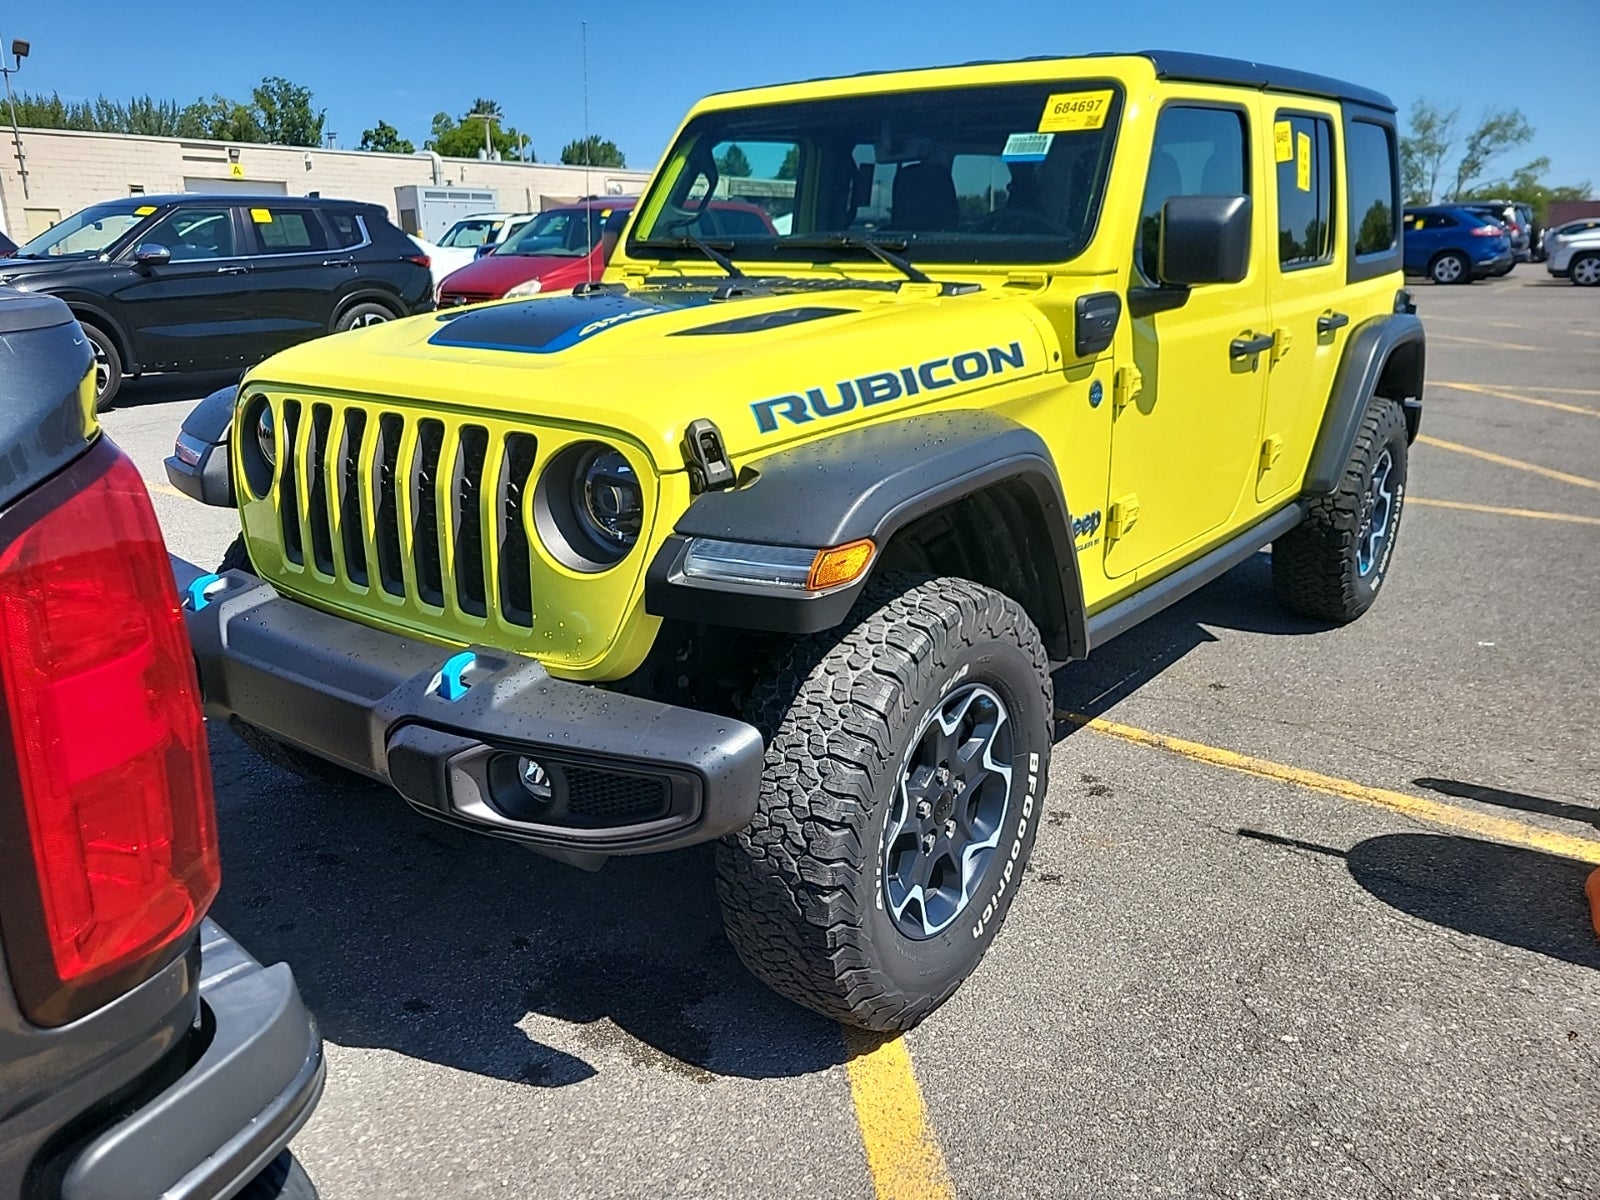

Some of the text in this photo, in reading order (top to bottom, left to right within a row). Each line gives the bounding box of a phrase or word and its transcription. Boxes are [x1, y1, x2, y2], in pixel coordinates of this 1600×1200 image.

[1054, 99, 1103, 114] 684697
[233, 166, 241, 175] A
[750, 342, 1024, 434] RUBICON
[1070, 510, 1101, 538] eep
[973, 752, 1039, 939] BFGoodrich
